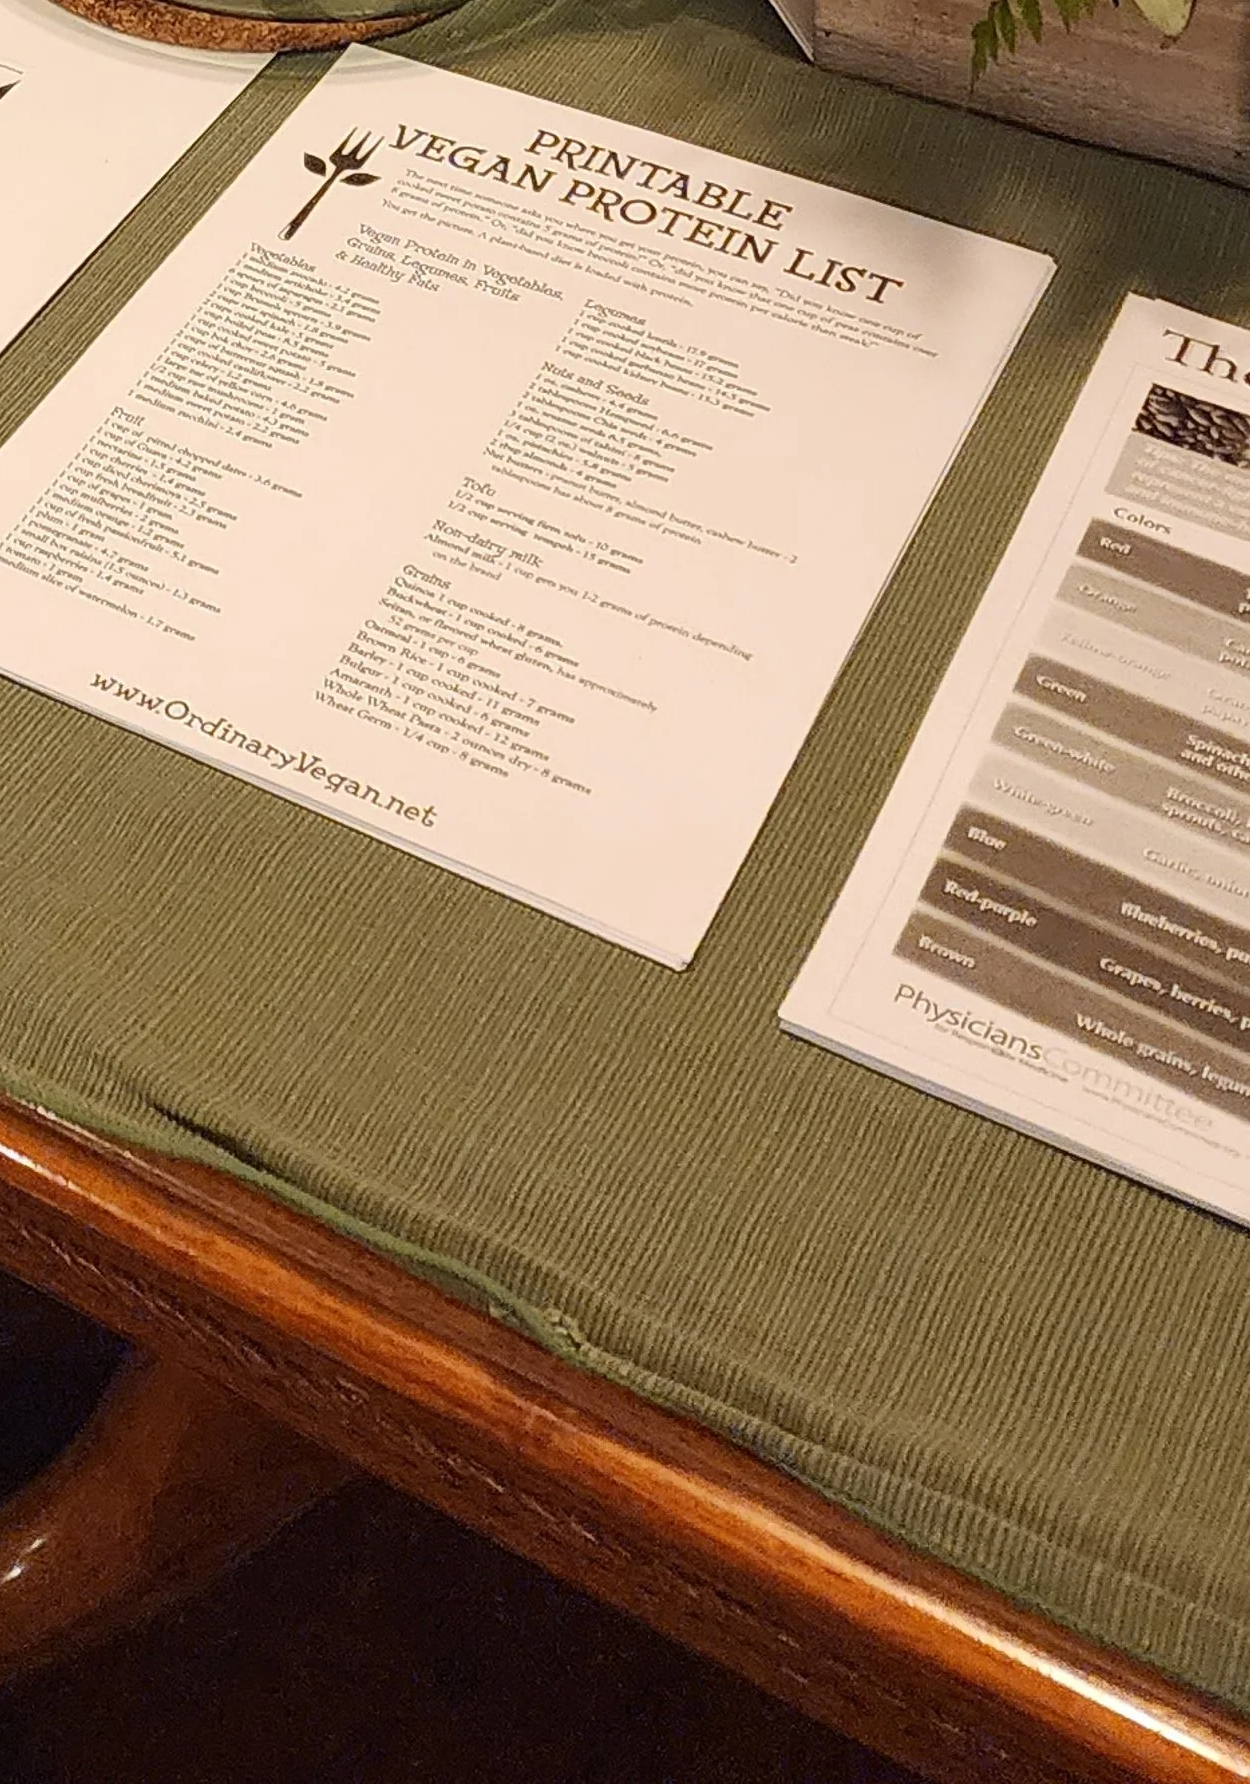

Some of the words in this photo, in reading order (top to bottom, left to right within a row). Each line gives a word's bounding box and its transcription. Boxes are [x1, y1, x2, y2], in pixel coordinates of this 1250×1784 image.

[523, 128, 793, 231] PRINTABLE
[388, 124, 557, 193] VEGAN
[557, 178, 779, 264] PROTEIN
[782, 247, 904, 304] LIST
[250, 241, 316, 272] Vegetables
[334, 250, 348, 261] &
[399, 254, 470, 286] Legumes,
[461, 258, 477, 271] in
[483, 263, 563, 301] Vegetables,
[429, 518, 508, 558] Non-dairy
[1113, 505, 1172, 536] Colors
[1100, 535, 1132, 556] Red
[386, 585, 448, 616] Buckwheat
[329, 667, 392, 698] Amaranth
[418, 615, 433, 623] or
[578, 677, 658, 713] approximately
[1035, 673, 1086, 703] Green
[89, 673, 437, 827] www.OrdinaryVegan.net
[1014, 724, 1115, 774] Green-white
[993, 776, 1094, 826] White-green
[967, 824, 1007, 852] Blue
[943, 878, 1038, 929] Red-purple
[1120, 900, 1225, 955] Blueberries,
[918, 935, 976, 970] Brown
[1099, 955, 1169, 999] Grapes,
[1170, 982, 1239, 1025] berries,
[1074, 1012, 1135, 1050] Whole
[1136, 1040, 1199, 1079] grains,
